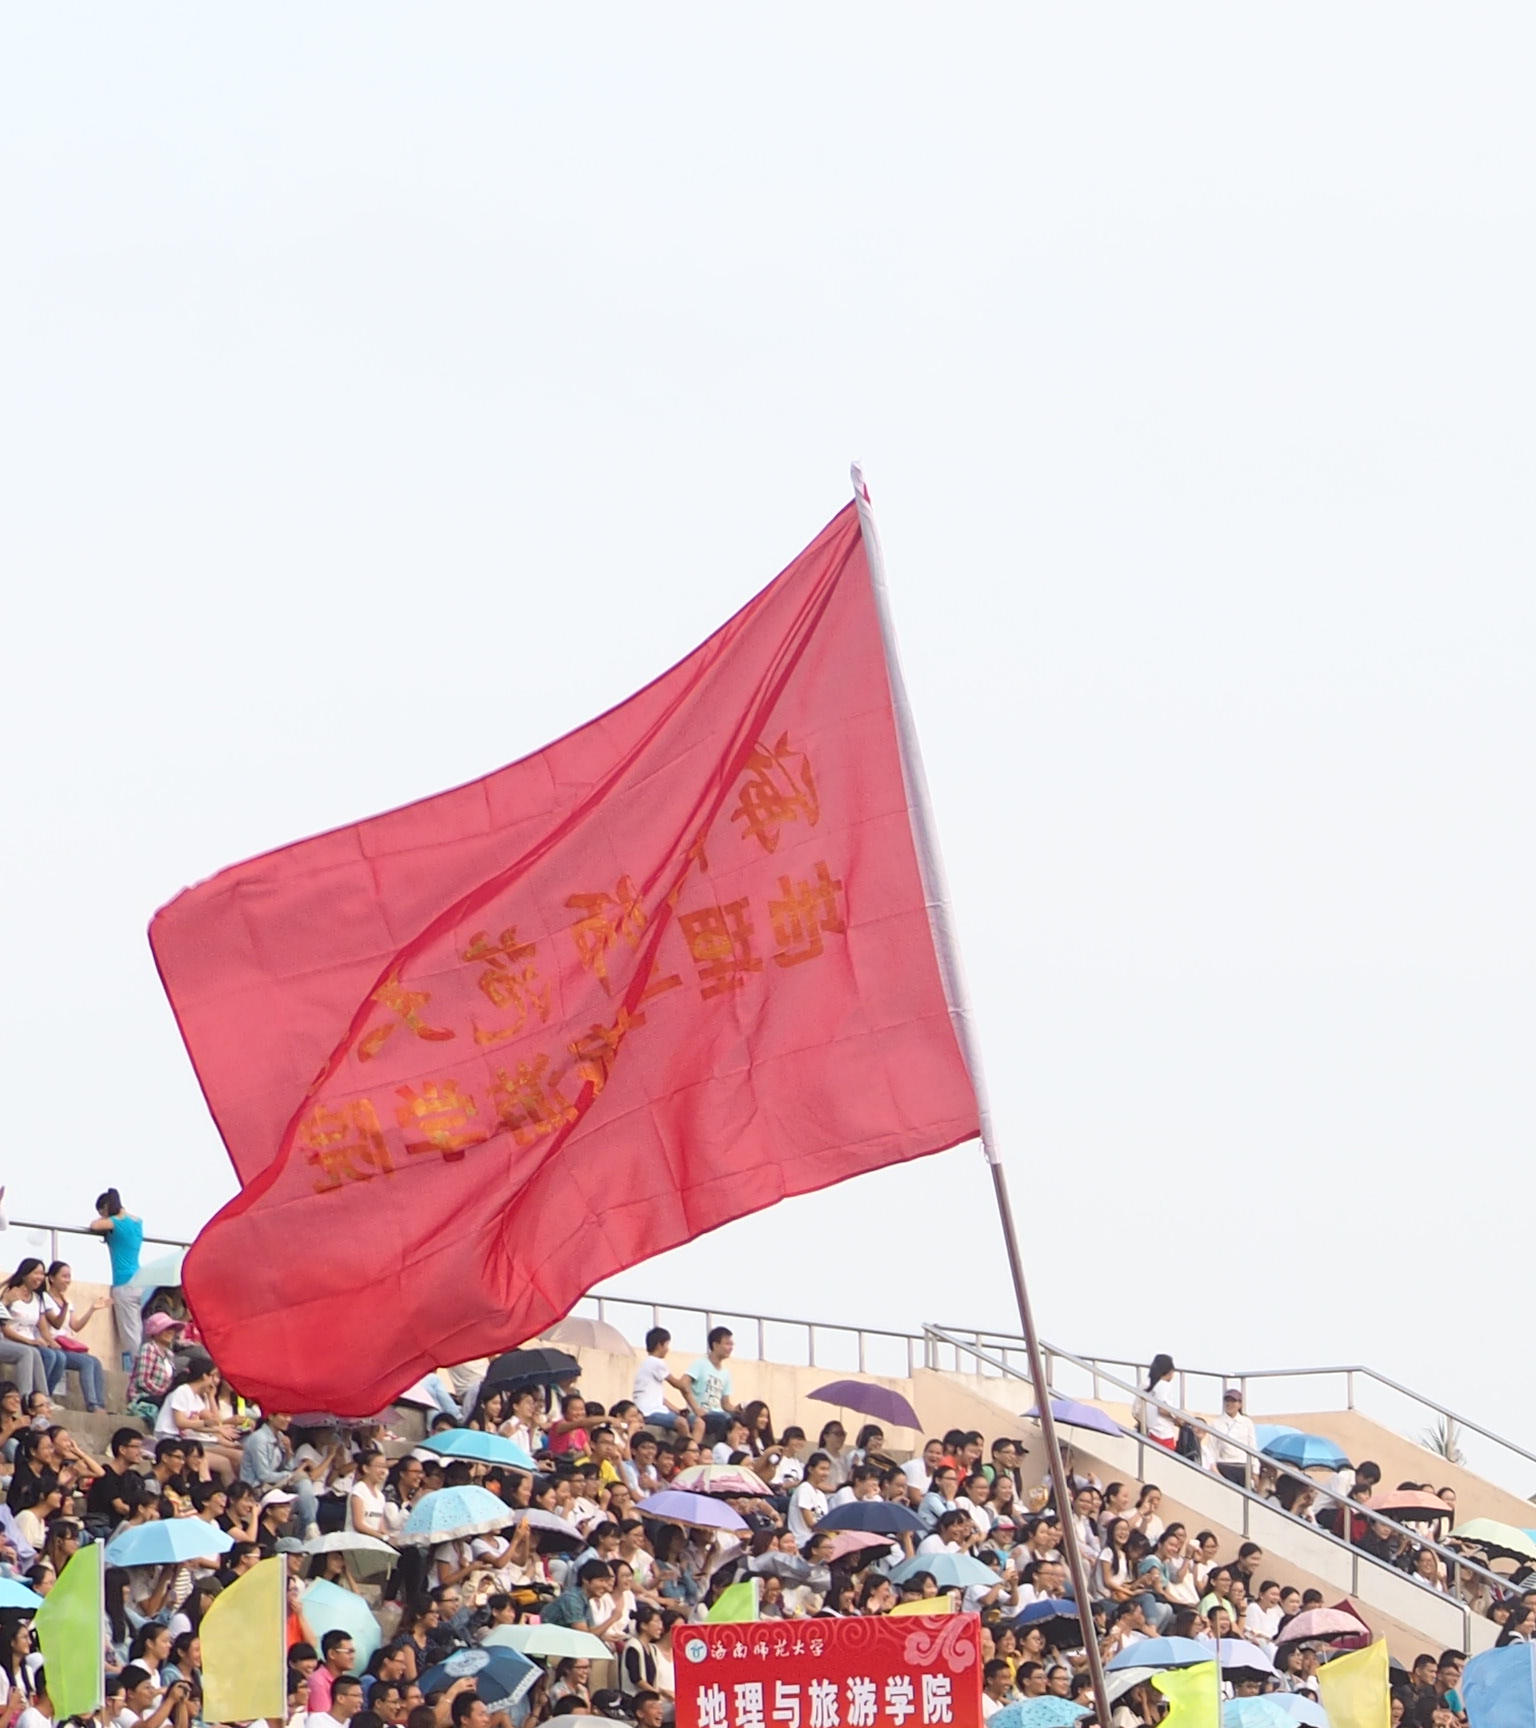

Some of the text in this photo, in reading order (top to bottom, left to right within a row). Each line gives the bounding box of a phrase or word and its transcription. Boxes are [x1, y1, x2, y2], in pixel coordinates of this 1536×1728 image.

[711, 1638, 824, 1661] 海南师范大学
